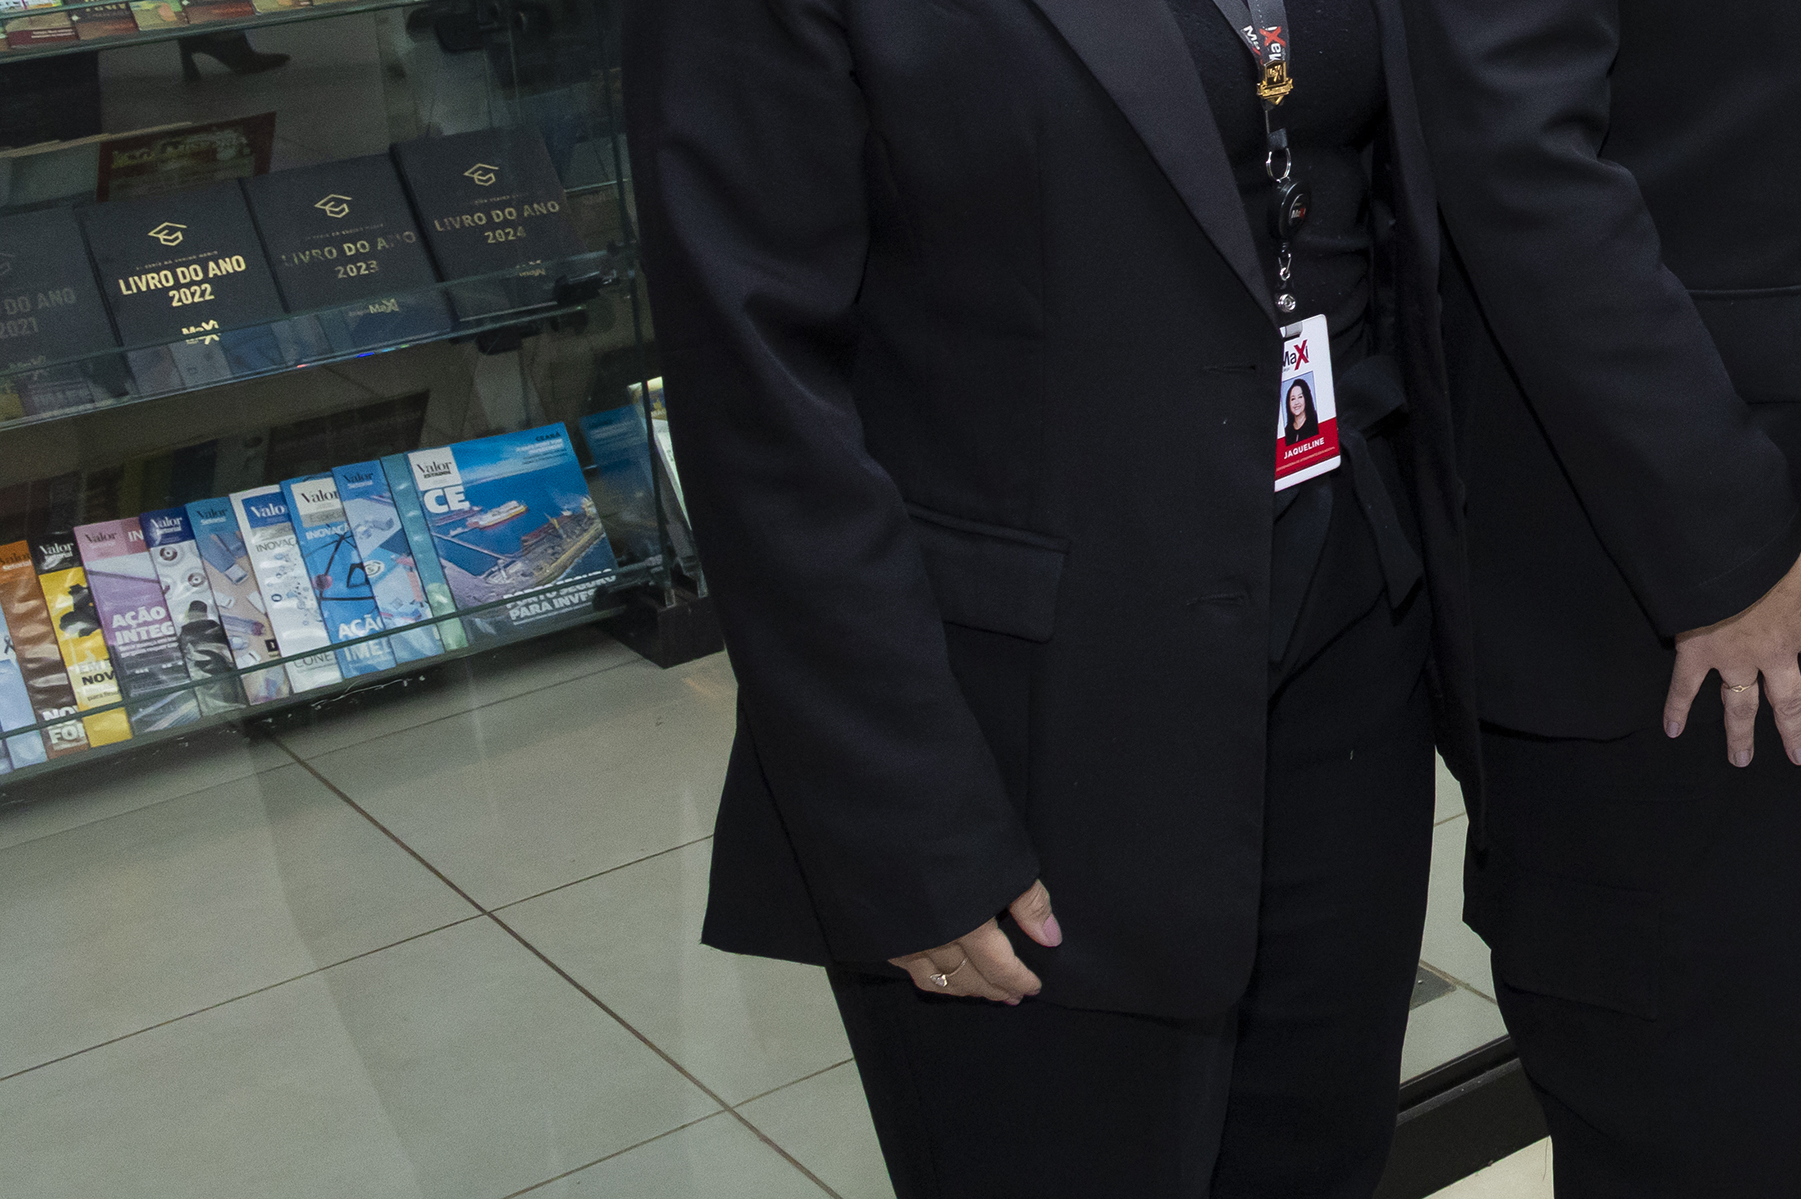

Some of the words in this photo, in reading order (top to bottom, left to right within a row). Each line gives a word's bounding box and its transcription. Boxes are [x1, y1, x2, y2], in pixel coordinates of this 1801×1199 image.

[433, 212, 488, 233] LIVRO
[491, 206, 518, 224] DO
[523, 200, 560, 217] ANO
[484, 225, 526, 244] 2024
[343, 239, 370, 256] DO
[118, 269, 174, 296] LIVRO
[176, 263, 204, 285] DO
[207, 254, 248, 279] ANO
[334, 259, 379, 279] 2023
[168, 282, 216, 308] 2022
[1283, 437, 1326, 460] JAQUELINE
[416, 460, 453, 474] Valor
[423, 484, 471, 515] CE
[150, 515, 183, 531] Valor
[112, 605, 166, 630] AÇÃO
[508, 600, 554, 621] PARA
[114, 623, 176, 647] INTEG
